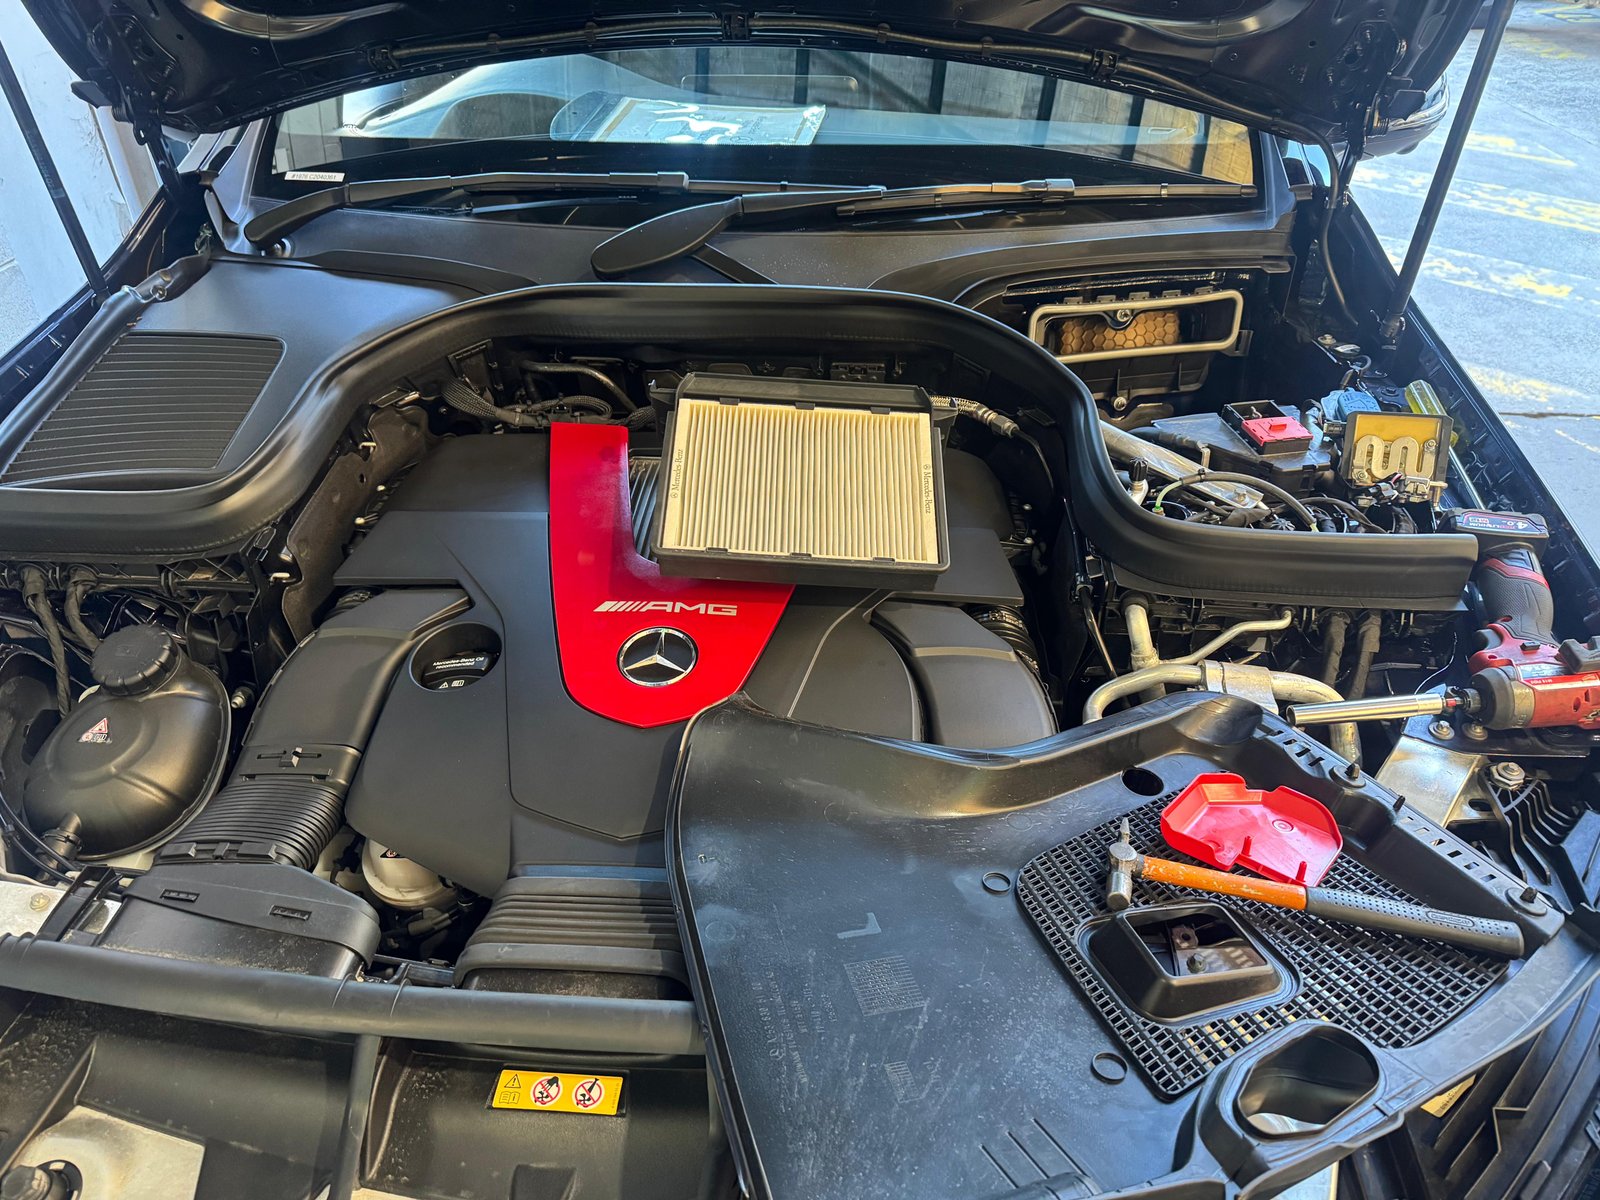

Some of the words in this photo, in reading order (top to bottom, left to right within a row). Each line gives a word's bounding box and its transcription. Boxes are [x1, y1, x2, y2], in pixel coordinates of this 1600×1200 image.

[923, 471, 933, 514] Mercedes-Benz
[639, 600, 738, 616] AMG
[432, 657, 476, 667] Mercedes-Benz
[435, 661, 476, 670] recommended
